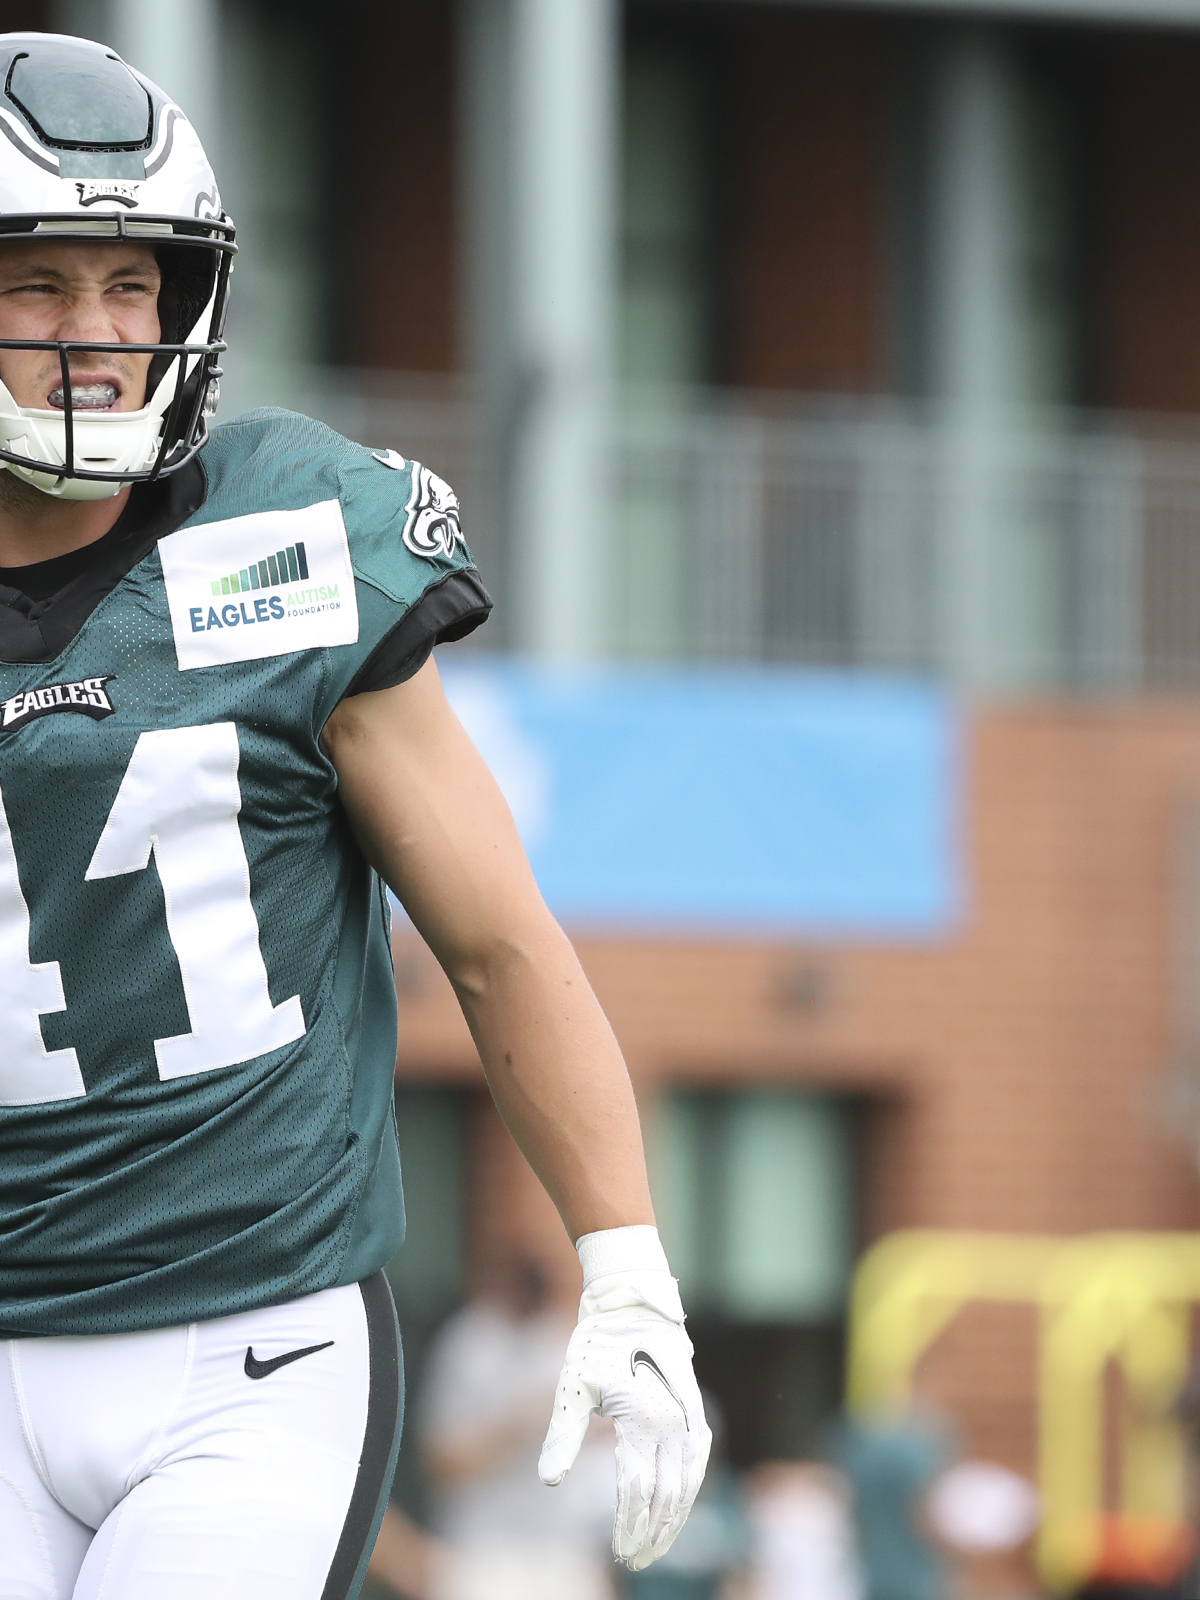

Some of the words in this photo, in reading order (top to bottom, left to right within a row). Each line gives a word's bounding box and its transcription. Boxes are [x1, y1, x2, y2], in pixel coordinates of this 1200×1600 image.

[77, 183, 139, 204] EAGLES
[189, 595, 285, 632] EAGLES
[286, 584, 339, 607] AUTISM
[287, 602, 341, 618] FOUNDATION
[0, 676, 112, 726] EAGLES
